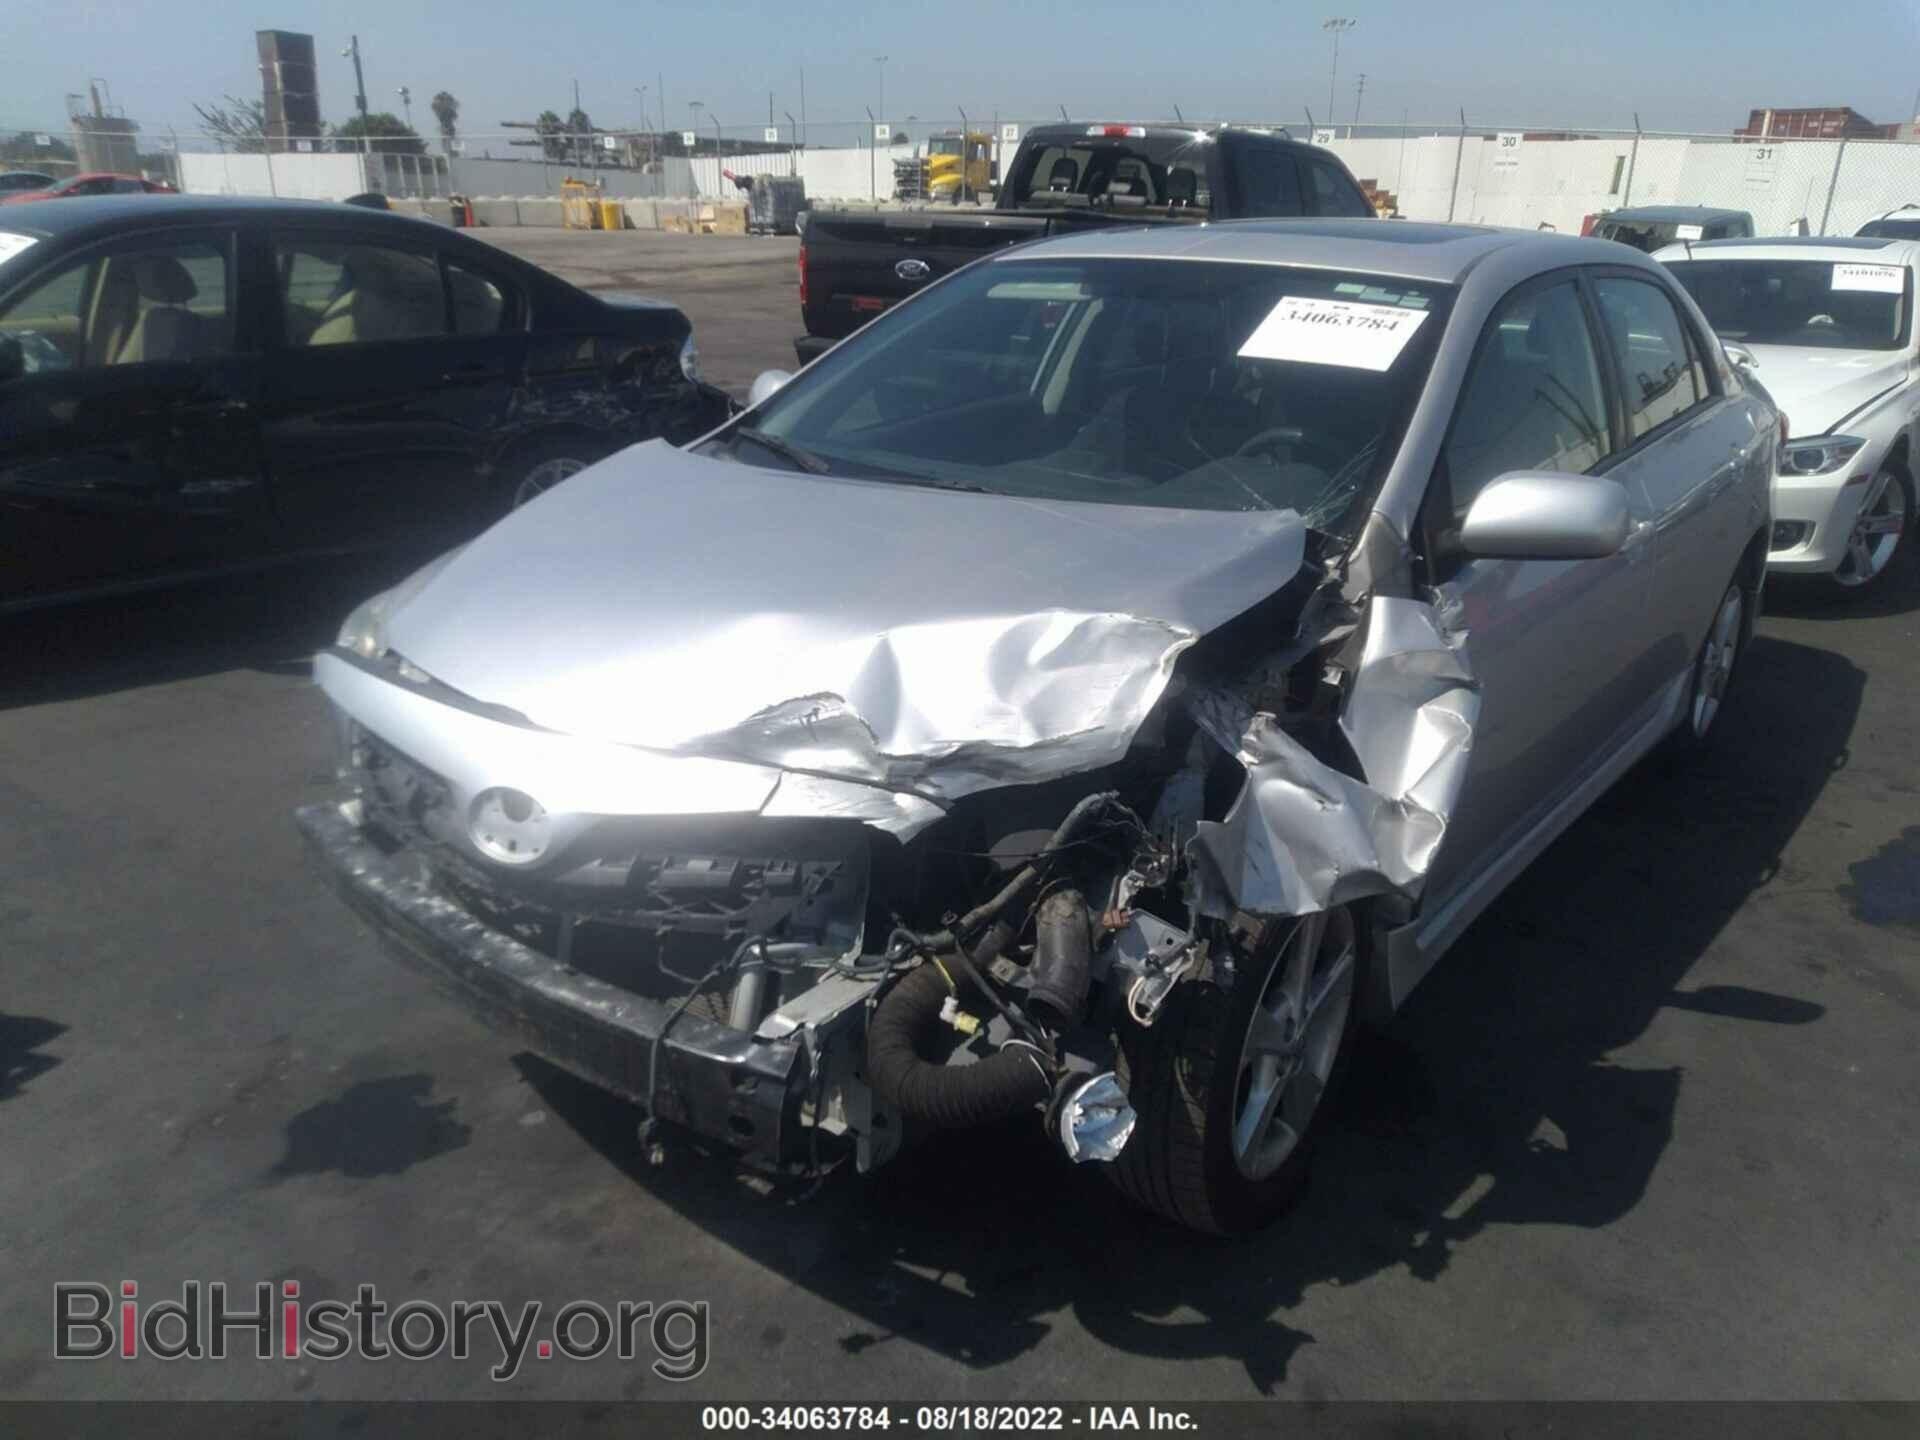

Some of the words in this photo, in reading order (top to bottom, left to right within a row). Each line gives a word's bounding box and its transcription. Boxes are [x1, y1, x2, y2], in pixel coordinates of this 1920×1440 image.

[1317, 133, 1330, 144] 29
[1502, 136, 1517, 147] 30
[1756, 148, 1772, 160] 31
[1281, 310, 1400, 332] 34063784
